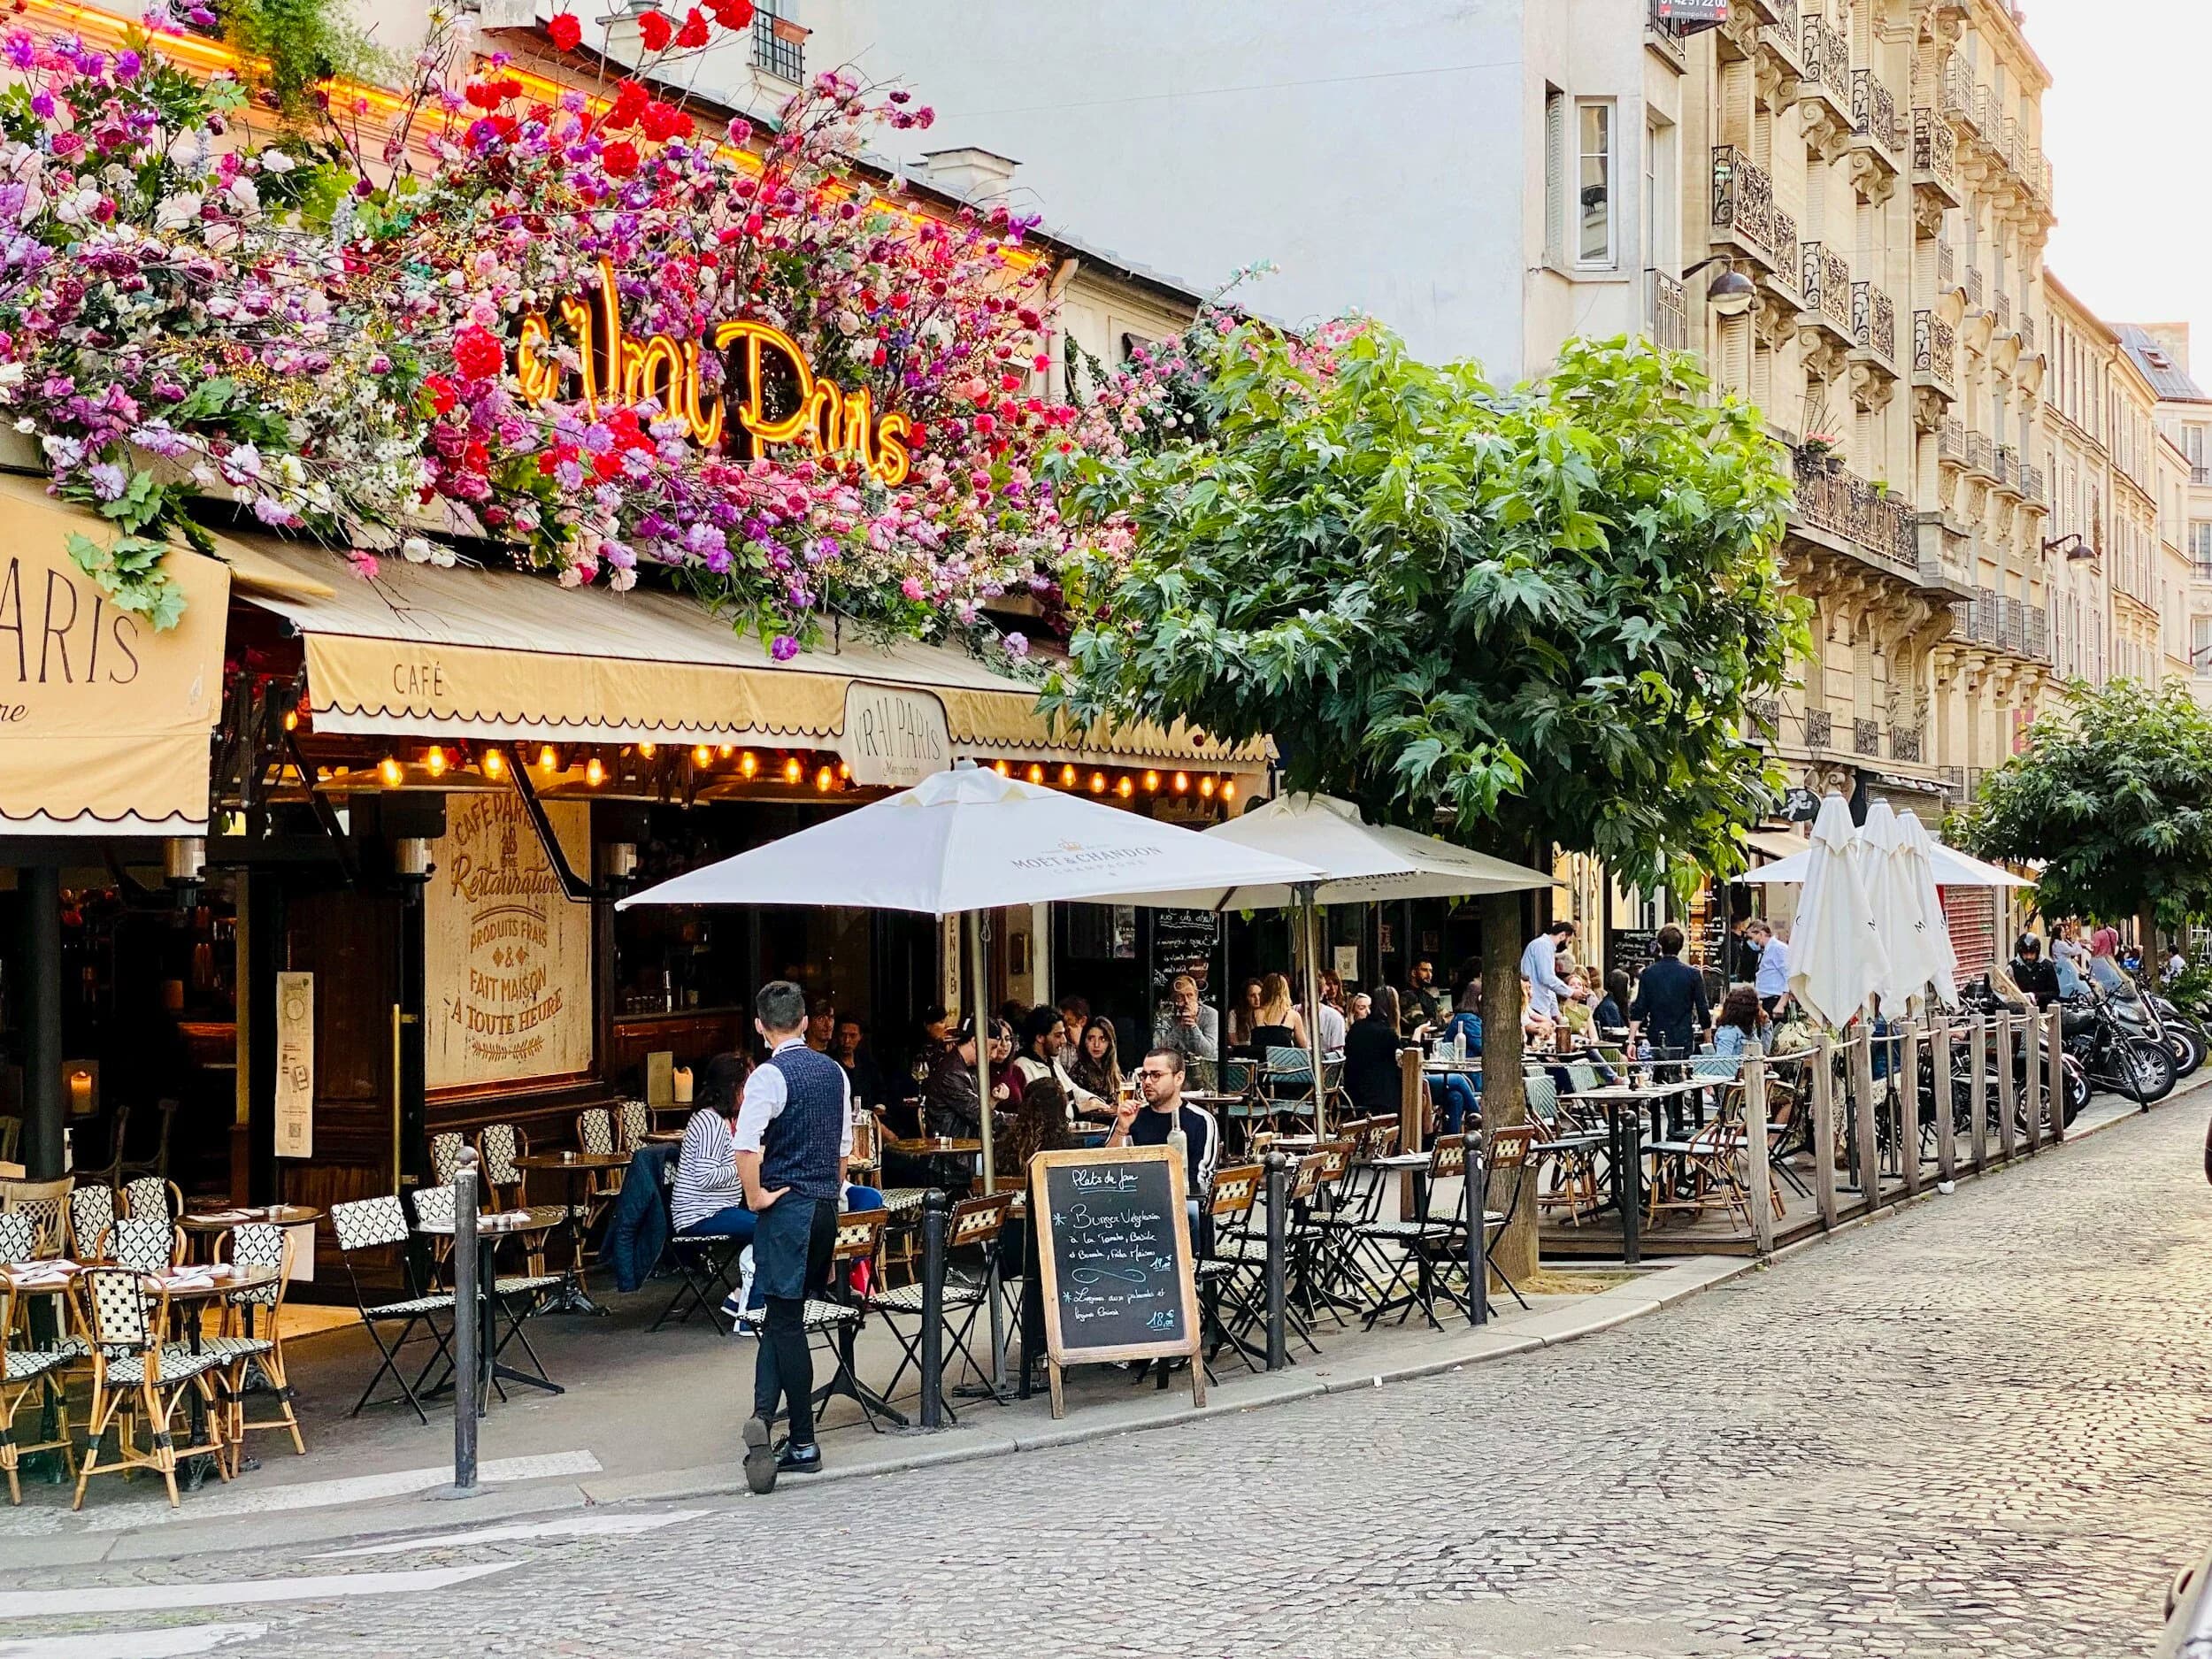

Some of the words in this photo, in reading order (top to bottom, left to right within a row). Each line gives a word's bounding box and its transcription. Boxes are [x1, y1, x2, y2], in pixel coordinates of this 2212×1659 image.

[394, 661, 442, 696] CAFÉ
[854, 697, 894, 757] VRAI
[895, 696, 941, 761] PARIS
[1075, 846, 1164, 864] CHANDON
[451, 853, 563, 903] Restauration
[470, 919, 518, 954] PRODUITS
[520, 920, 548, 949] FRAIS
[504, 945, 514, 968] &
[470, 966, 499, 1002] FAIT
[501, 964, 547, 1002] MAISON
[466, 1004, 515, 1035] TOUTE
[518, 987, 564, 1033] HEURE
[1070, 1203, 1119, 1229] Burger
[1068, 1235, 1079, 1244] à
[1083, 1232, 1096, 1244] la
